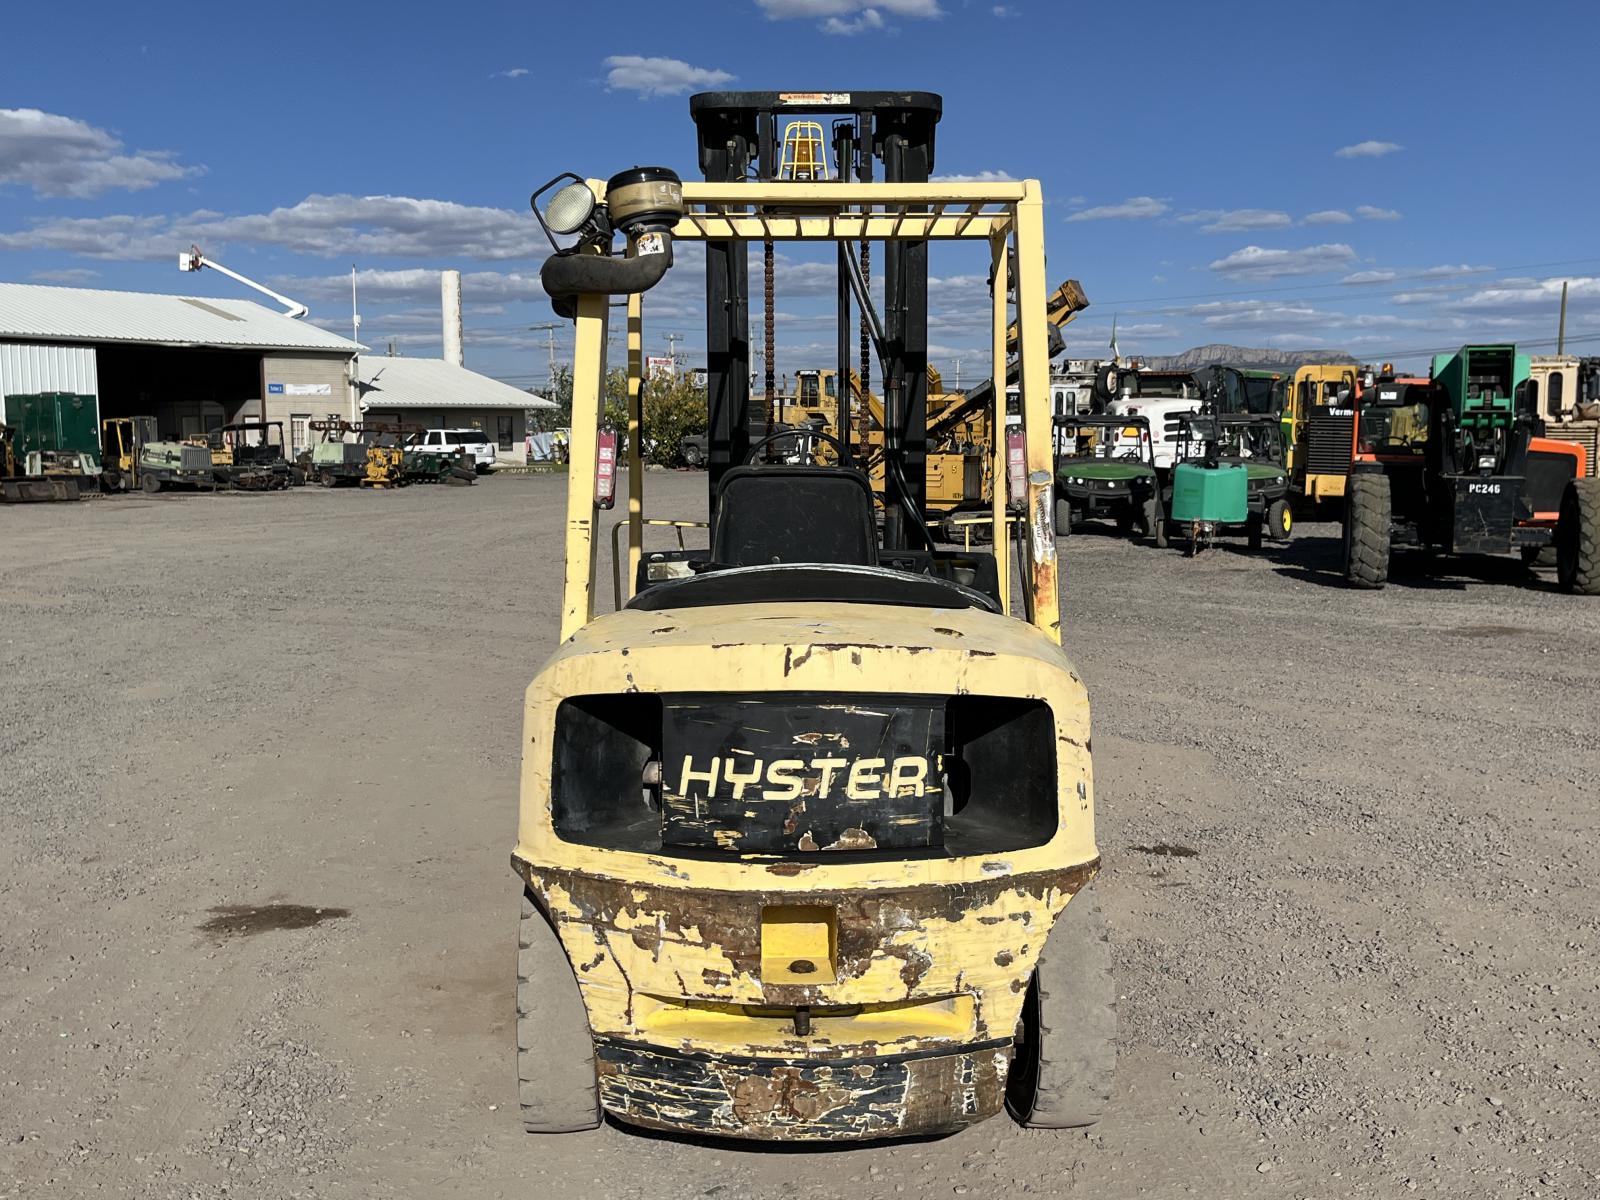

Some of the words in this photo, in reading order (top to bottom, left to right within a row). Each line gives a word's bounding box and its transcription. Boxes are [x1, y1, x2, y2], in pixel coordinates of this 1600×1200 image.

[1329, 407, 1366, 416] Vermr
[1469, 484, 1501, 494] PC246
[678, 755, 928, 801] HYSTER
